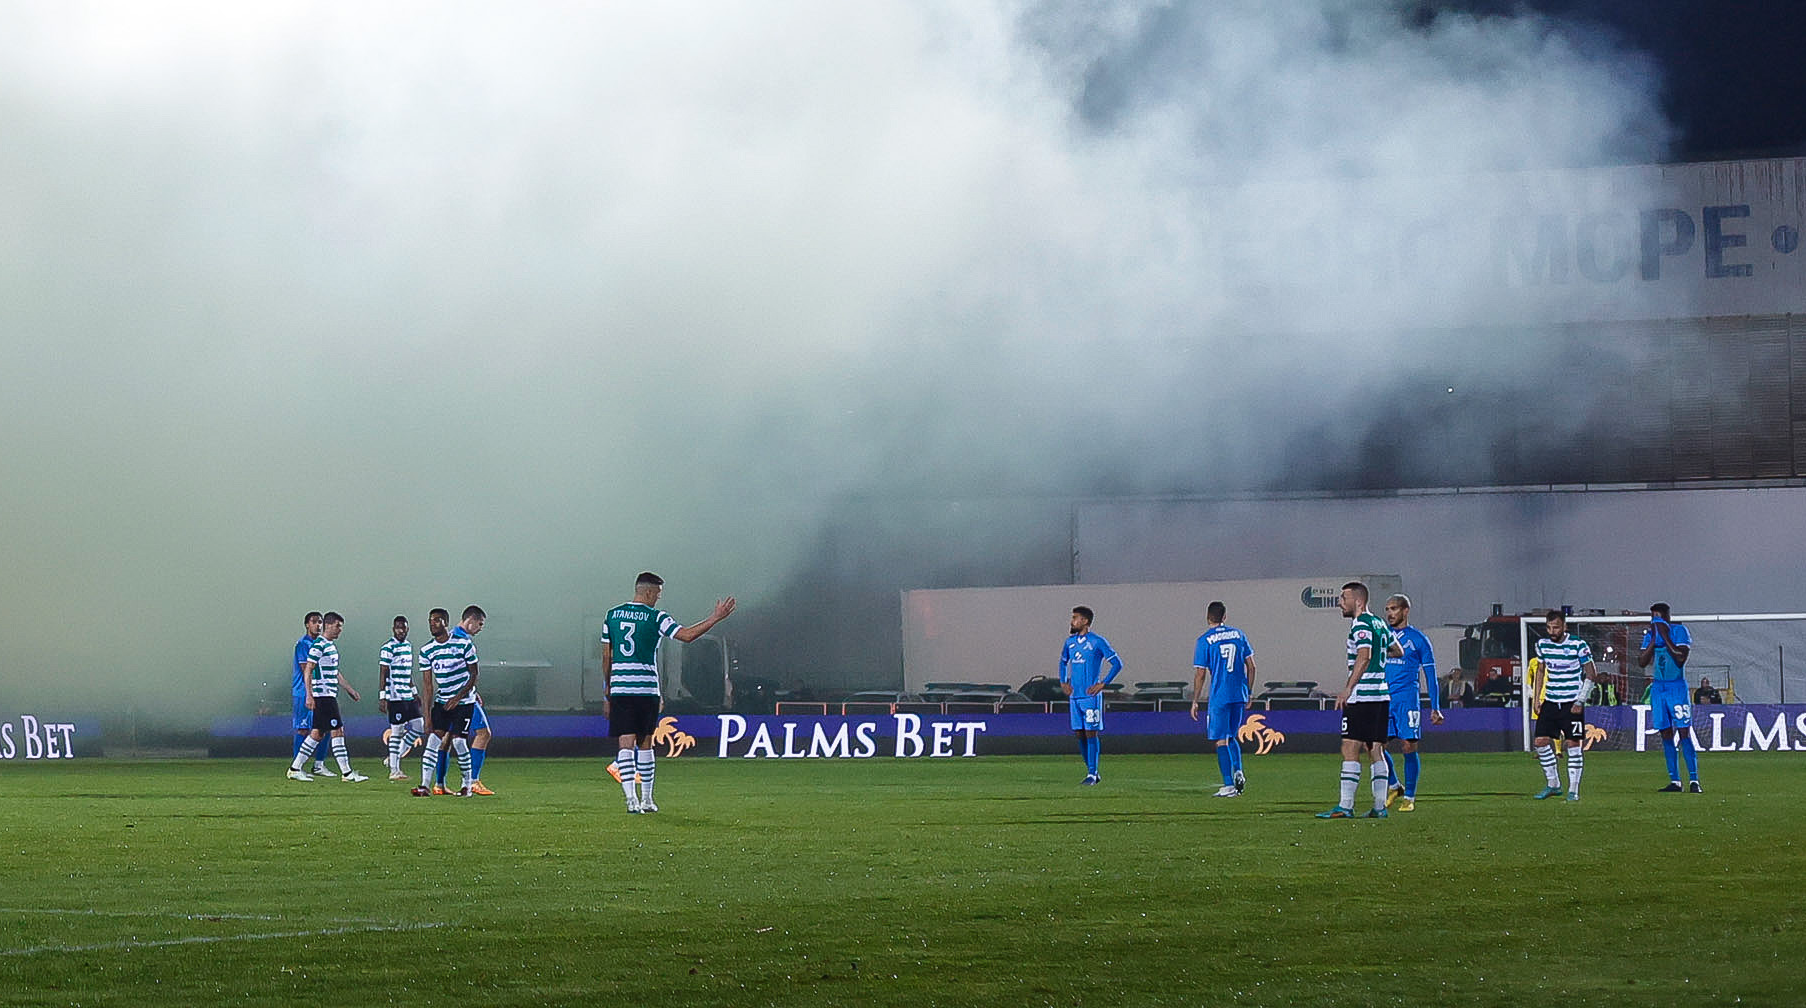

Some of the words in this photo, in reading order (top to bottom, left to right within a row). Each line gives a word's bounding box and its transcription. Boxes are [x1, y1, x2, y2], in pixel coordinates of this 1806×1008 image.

[1495, 204, 1754, 289] МОРЕ
[611, 609, 650, 622] ATANASOV
[619, 621, 636, 657] 3
[1219, 643, 1237, 673] 7
[1673, 704, 1691, 720] 33
[463, 718, 471, 731] 7
[1571, 721, 1583, 734] 71
